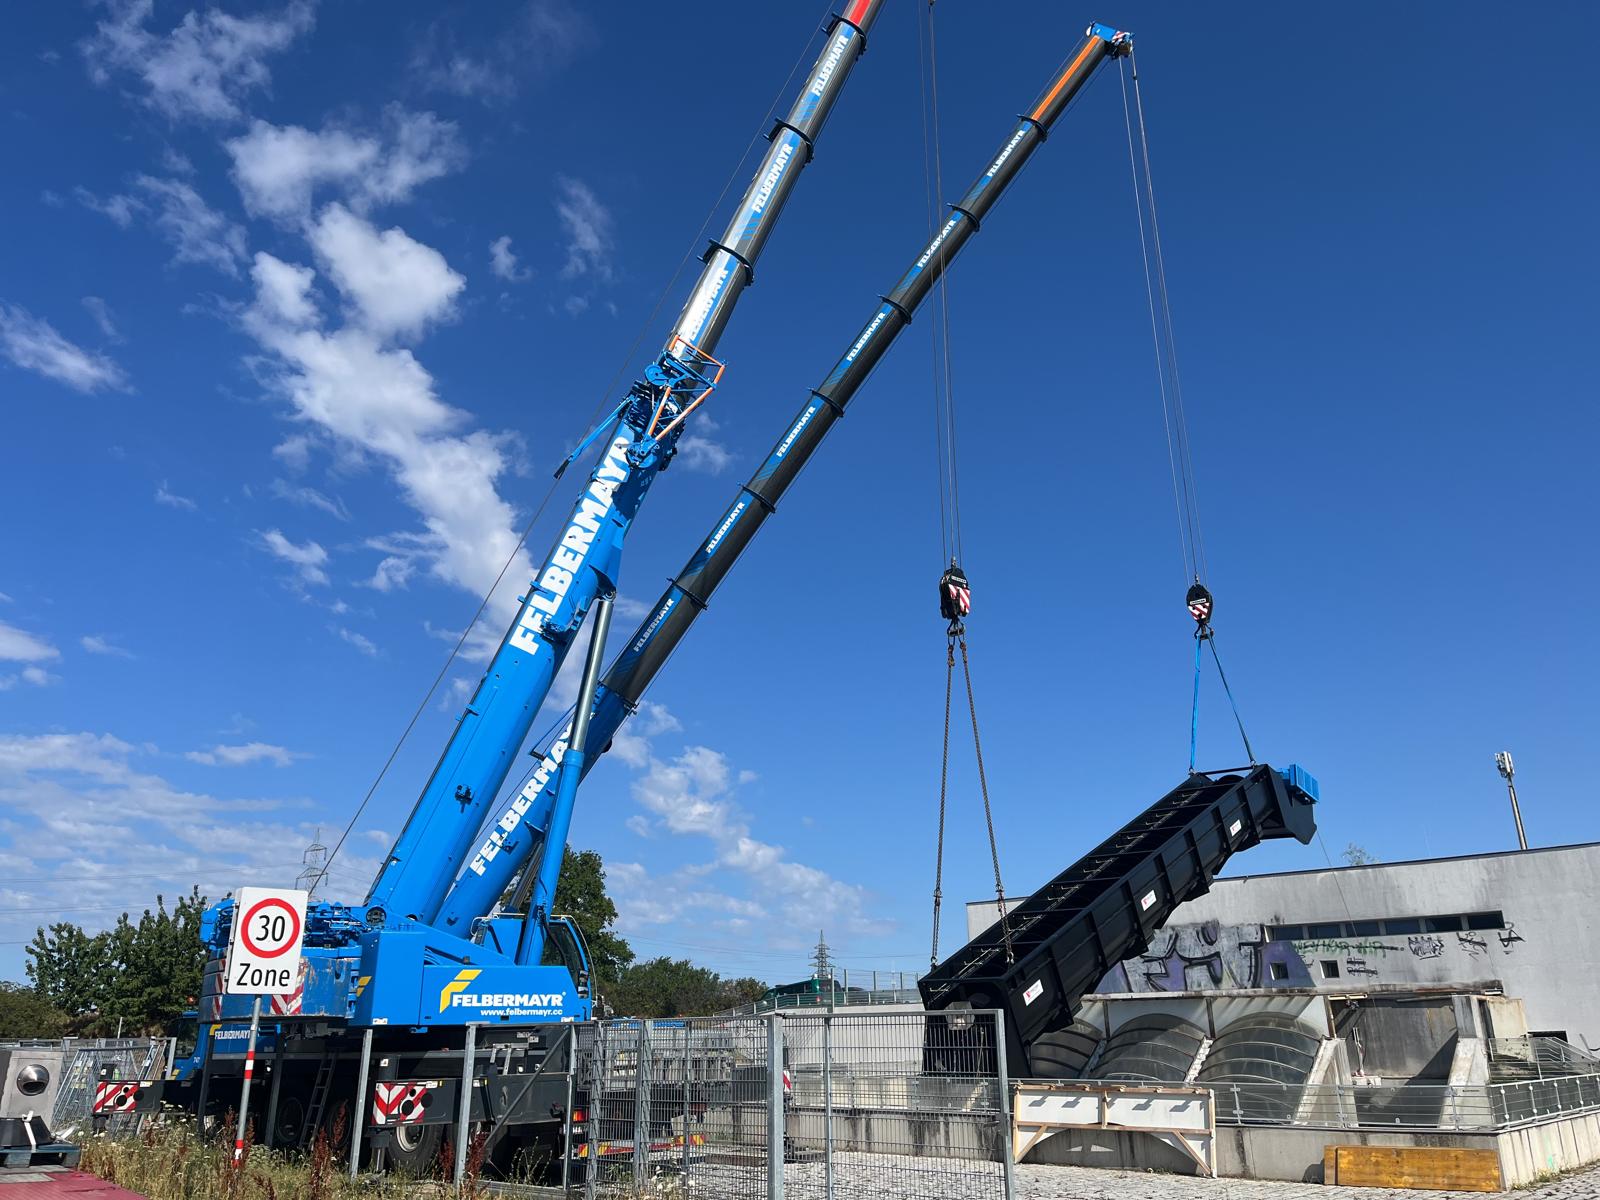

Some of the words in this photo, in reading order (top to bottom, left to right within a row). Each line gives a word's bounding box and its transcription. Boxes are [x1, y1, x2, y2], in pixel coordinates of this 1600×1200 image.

[812, 35, 849, 96] FELBERMAYR
[751, 143, 793, 214] FELBERMAYR
[846, 312, 886, 361] FELBERMAYR
[776, 406, 816, 457] FELBERMAYR
[705, 501, 746, 553] FELBERMAYR
[633, 598, 675, 652] FELBERMAYR
[470, 712, 596, 876] FELBERMA
[256, 915, 285, 942] 30
[236, 962, 290, 987] Zone
[214, 1029, 251, 1039] FELBERMAY
[480, 1008, 563, 1017] www.felbermayr.cc
